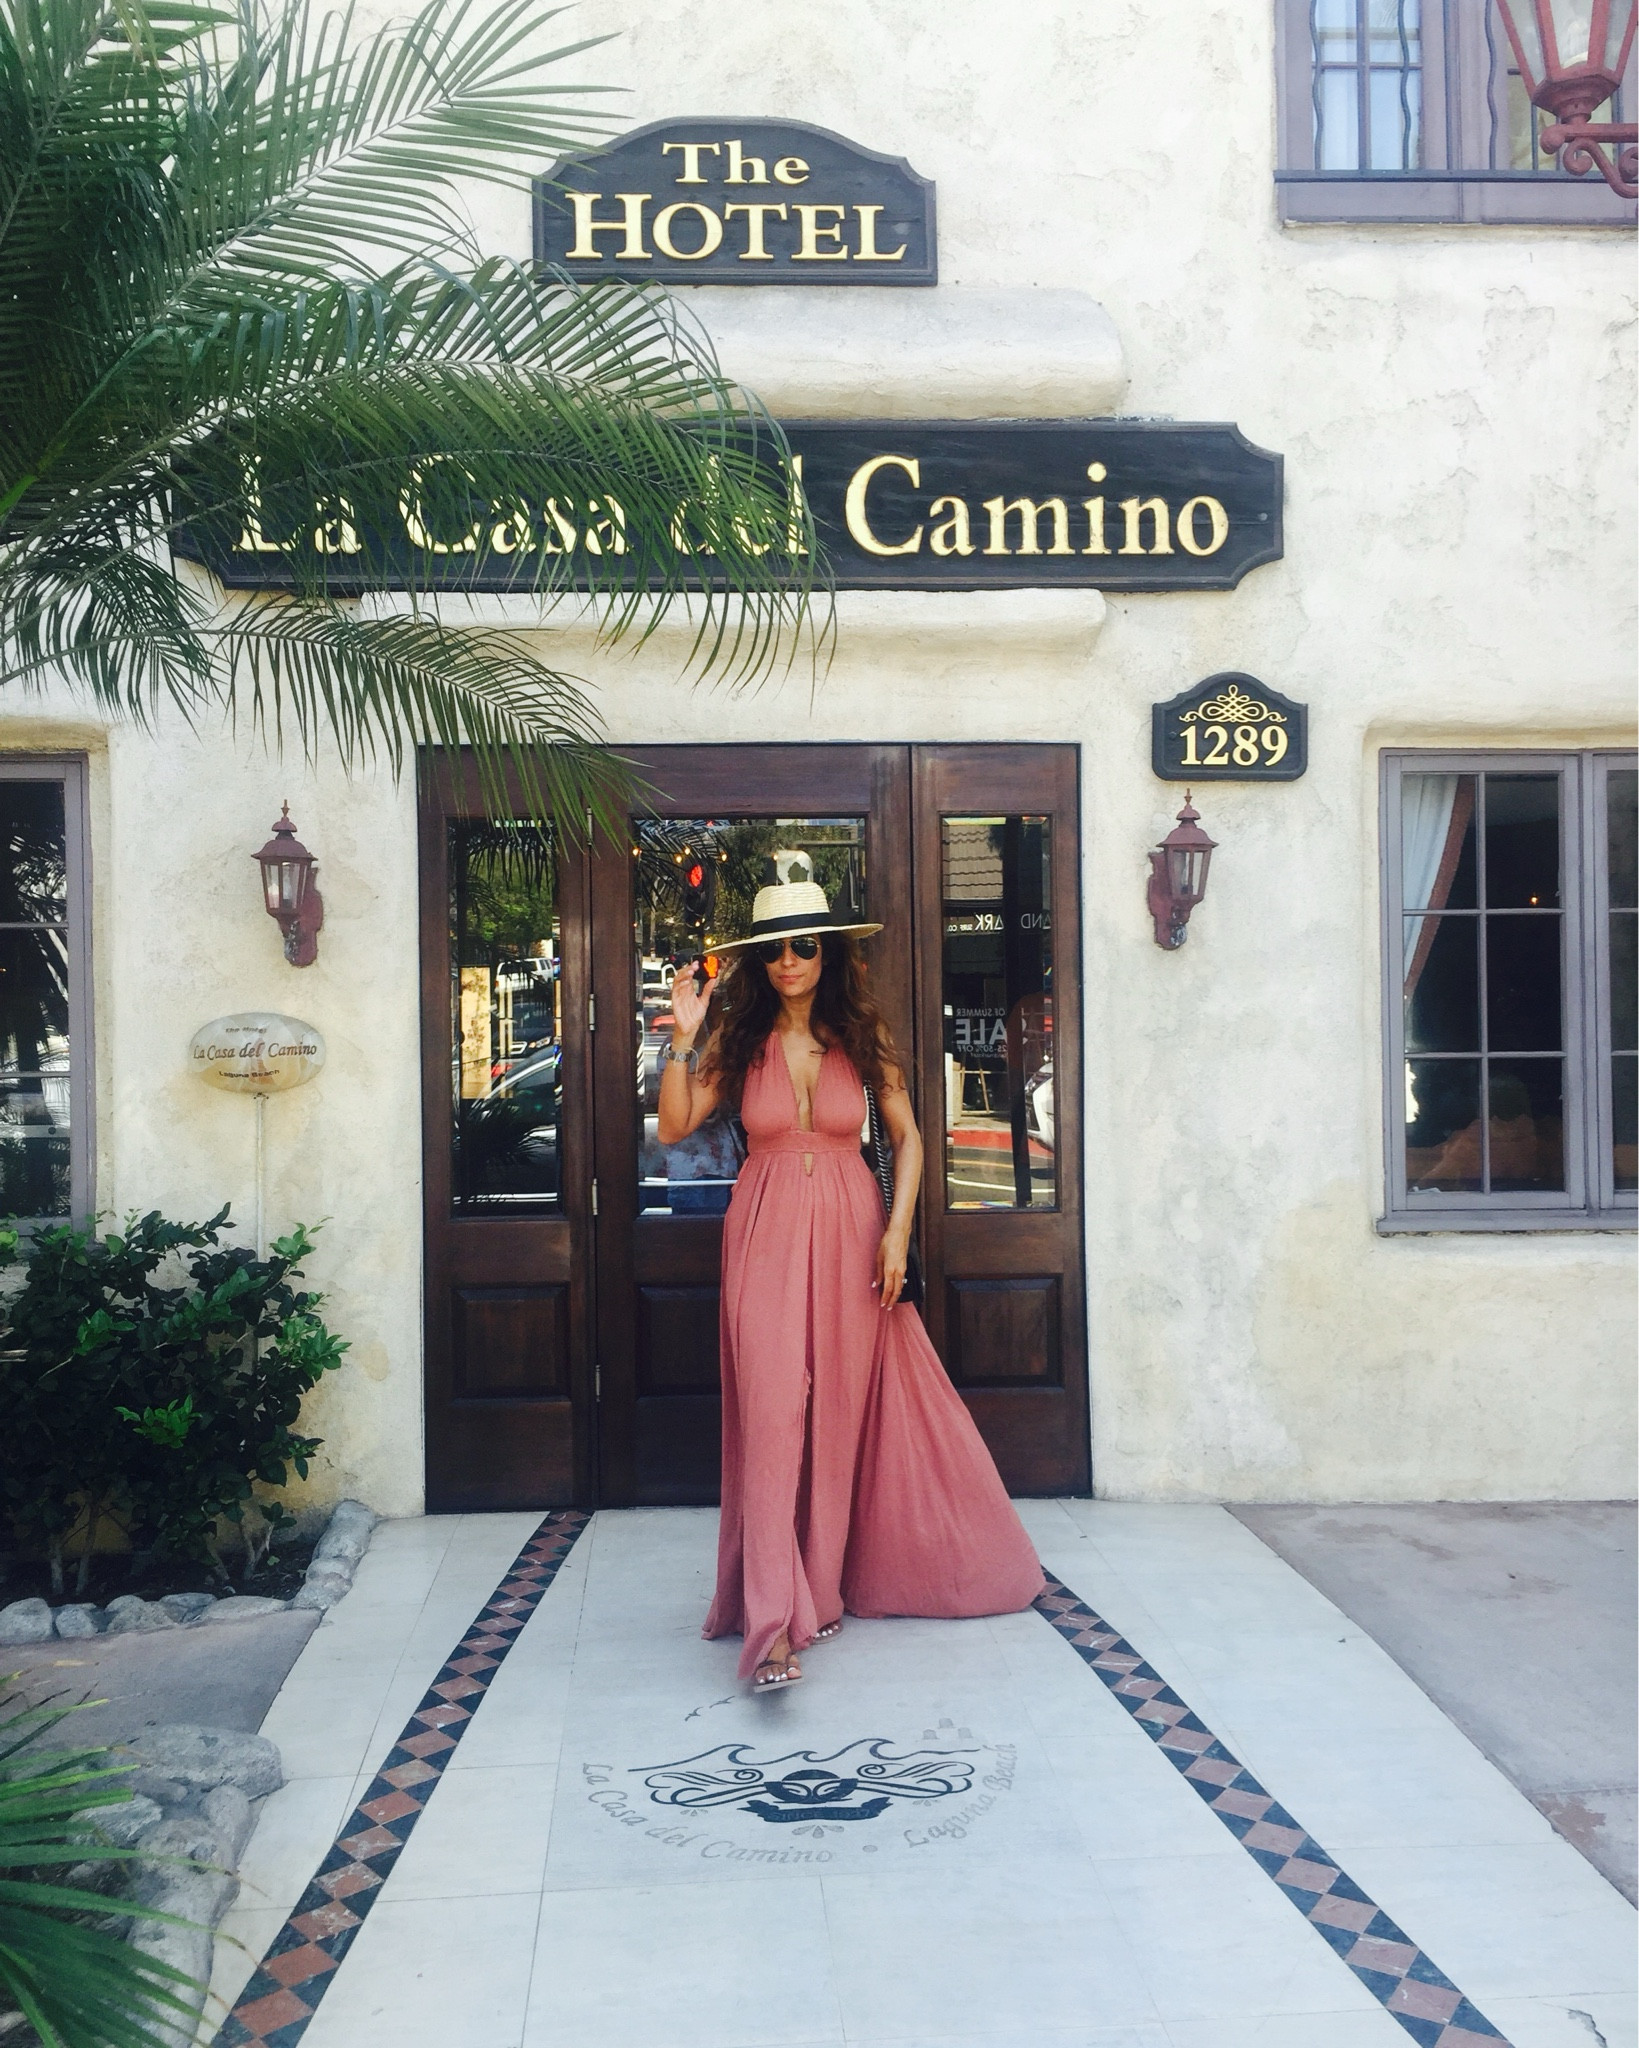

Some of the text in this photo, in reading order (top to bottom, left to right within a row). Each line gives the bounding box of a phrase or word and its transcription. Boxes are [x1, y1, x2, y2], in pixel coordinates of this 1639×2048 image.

[662, 140, 811, 185] The
[565, 193, 907, 261] HOTEL
[845, 454, 1229, 557] Camino
[1179, 725, 1288, 766] 1289
[193, 1042, 317, 1060] La Casa del Camino
[583, 1762, 833, 1864] La Casa del Camino
[903, 1743, 1018, 1849] Laguna Beach
